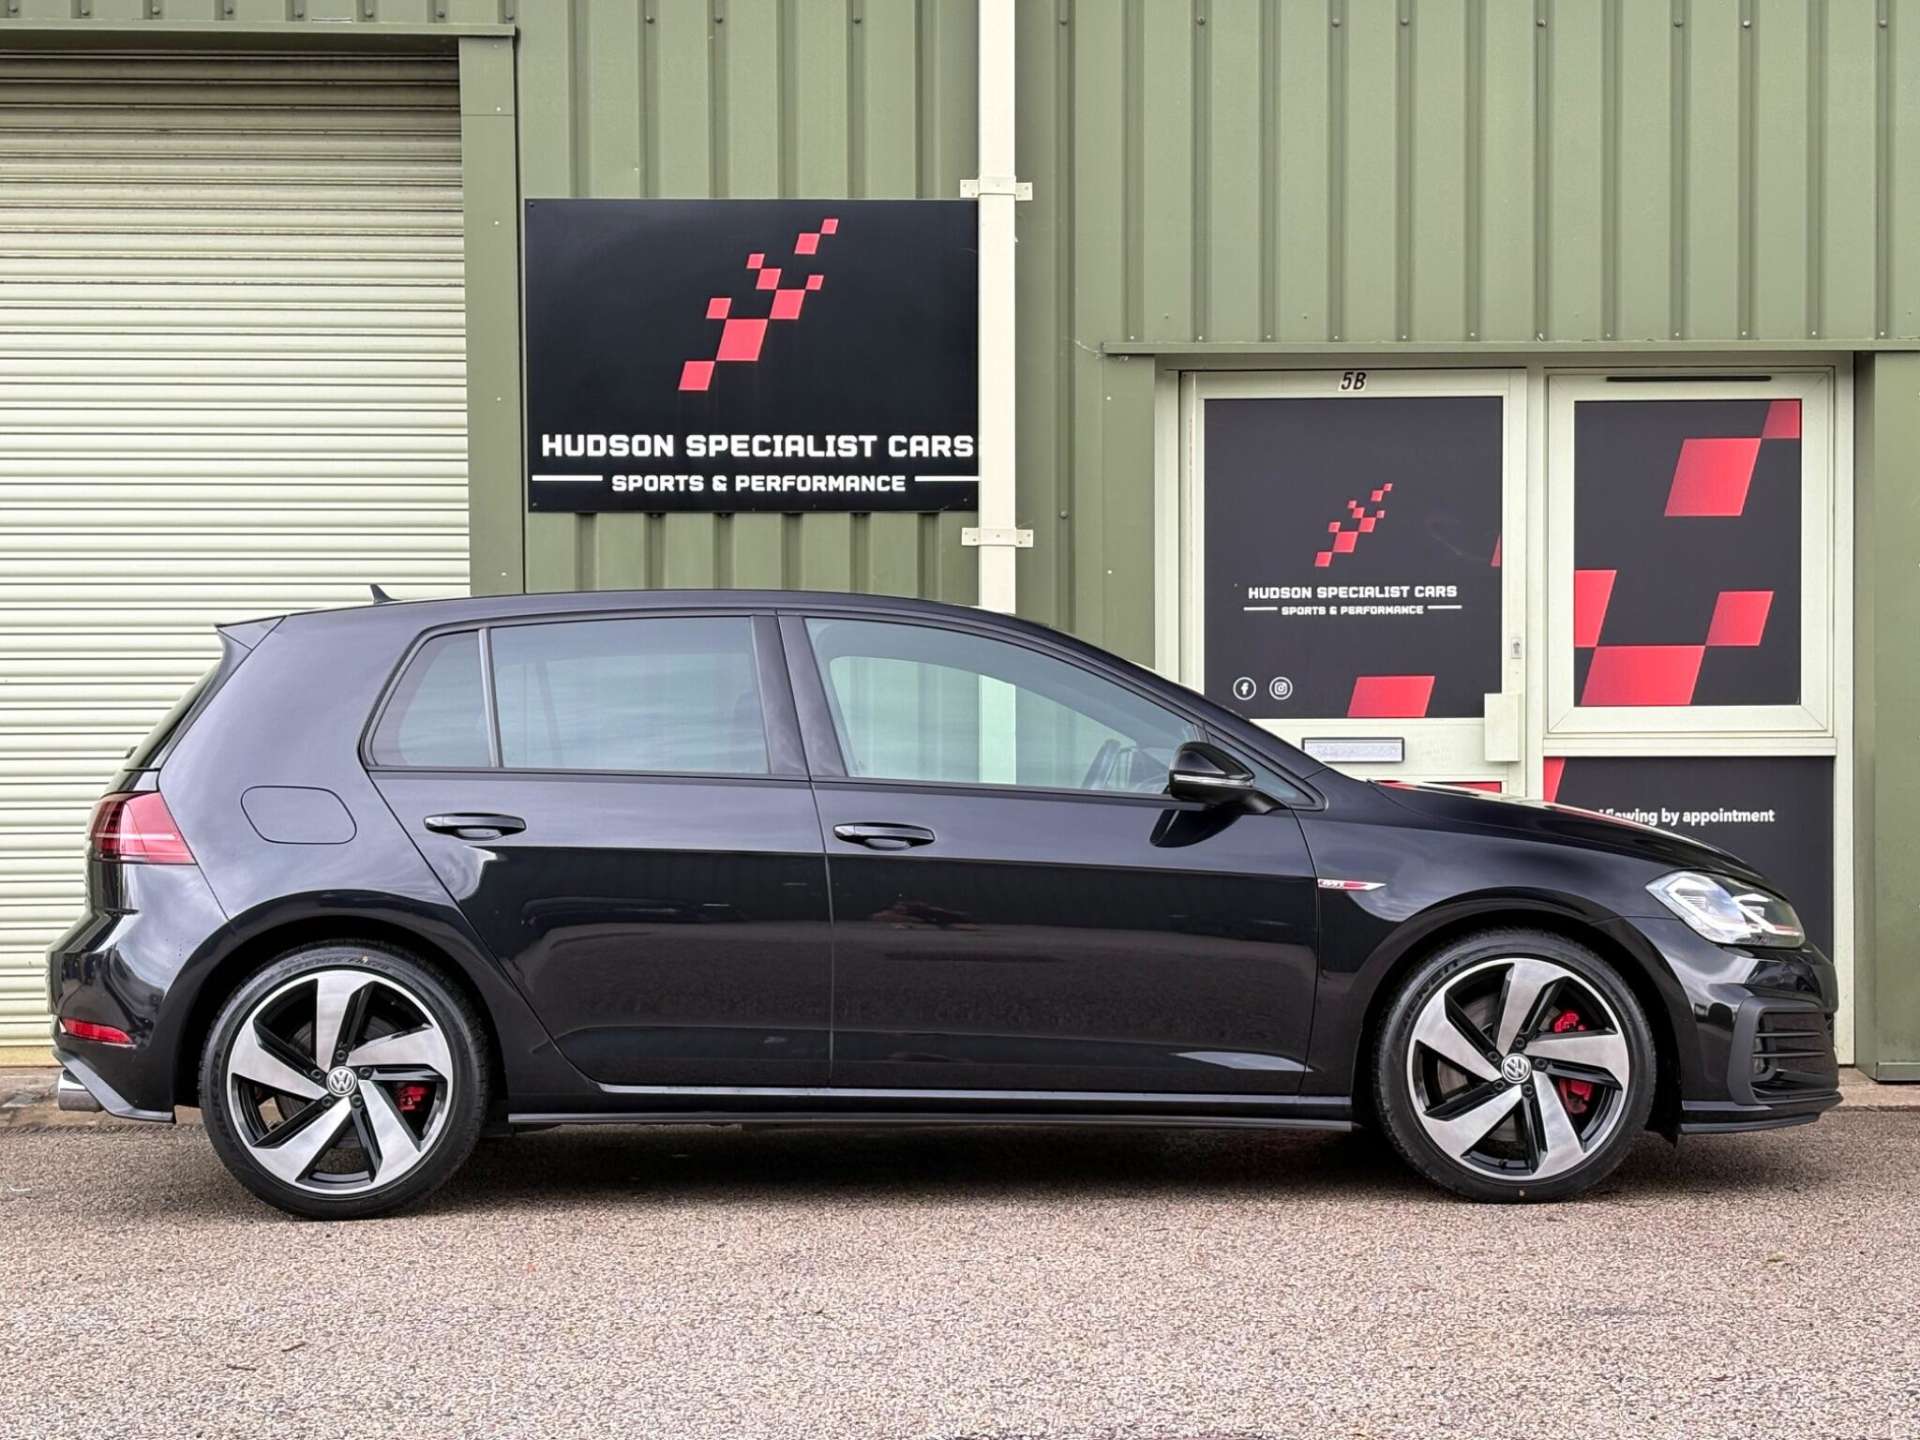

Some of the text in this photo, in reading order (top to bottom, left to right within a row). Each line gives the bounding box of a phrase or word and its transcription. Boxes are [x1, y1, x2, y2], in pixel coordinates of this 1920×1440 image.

[1341, 371, 1367, 390] 5B
[542, 434, 973, 457] HUDSON SPECIALIST CARS
[612, 475, 905, 491] SPORTS & PERFORMANCE
[1248, 585, 1458, 599] HUDSON SPECIALIST CARS
[1281, 606, 1326, 615] SPORTS
[1340, 605, 1424, 615] PERFORMANCE
[1598, 808, 1775, 826] wing by appointment
